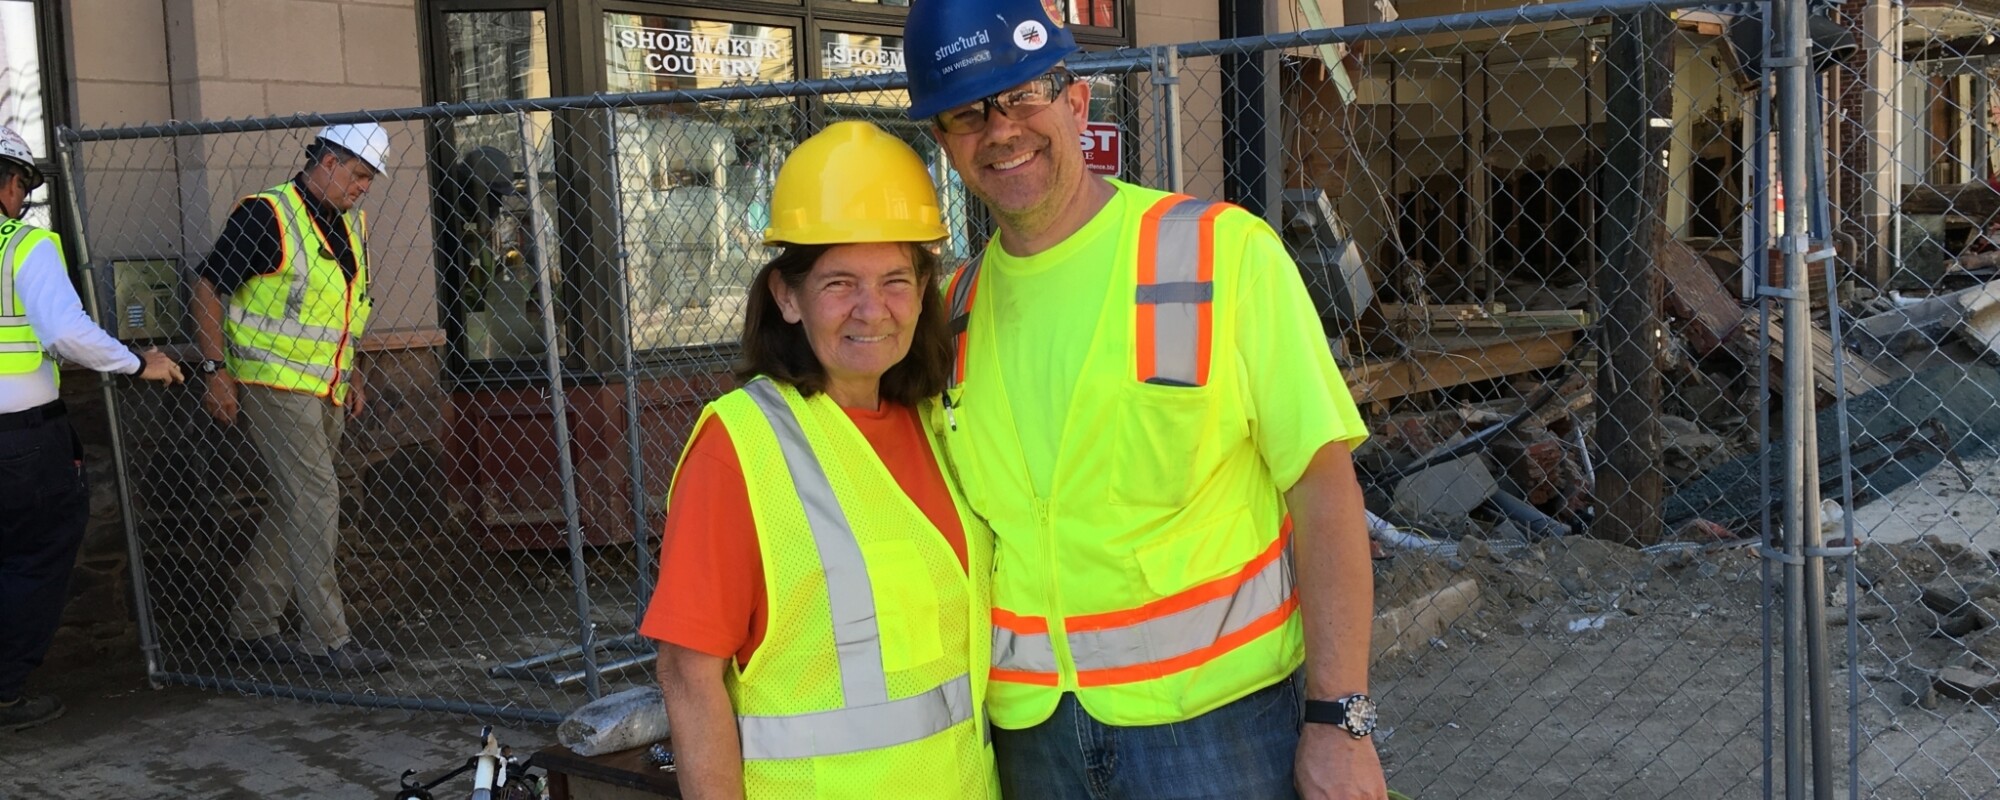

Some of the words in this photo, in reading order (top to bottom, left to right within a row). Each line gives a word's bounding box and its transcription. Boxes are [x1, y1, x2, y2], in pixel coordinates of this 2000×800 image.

[620, 29, 780, 60] SHOEMAKER
[644, 53, 762, 78] COUNTRY
[941, 65, 954, 75] IAN
[953, 50, 991, 70] WIENHOLT
